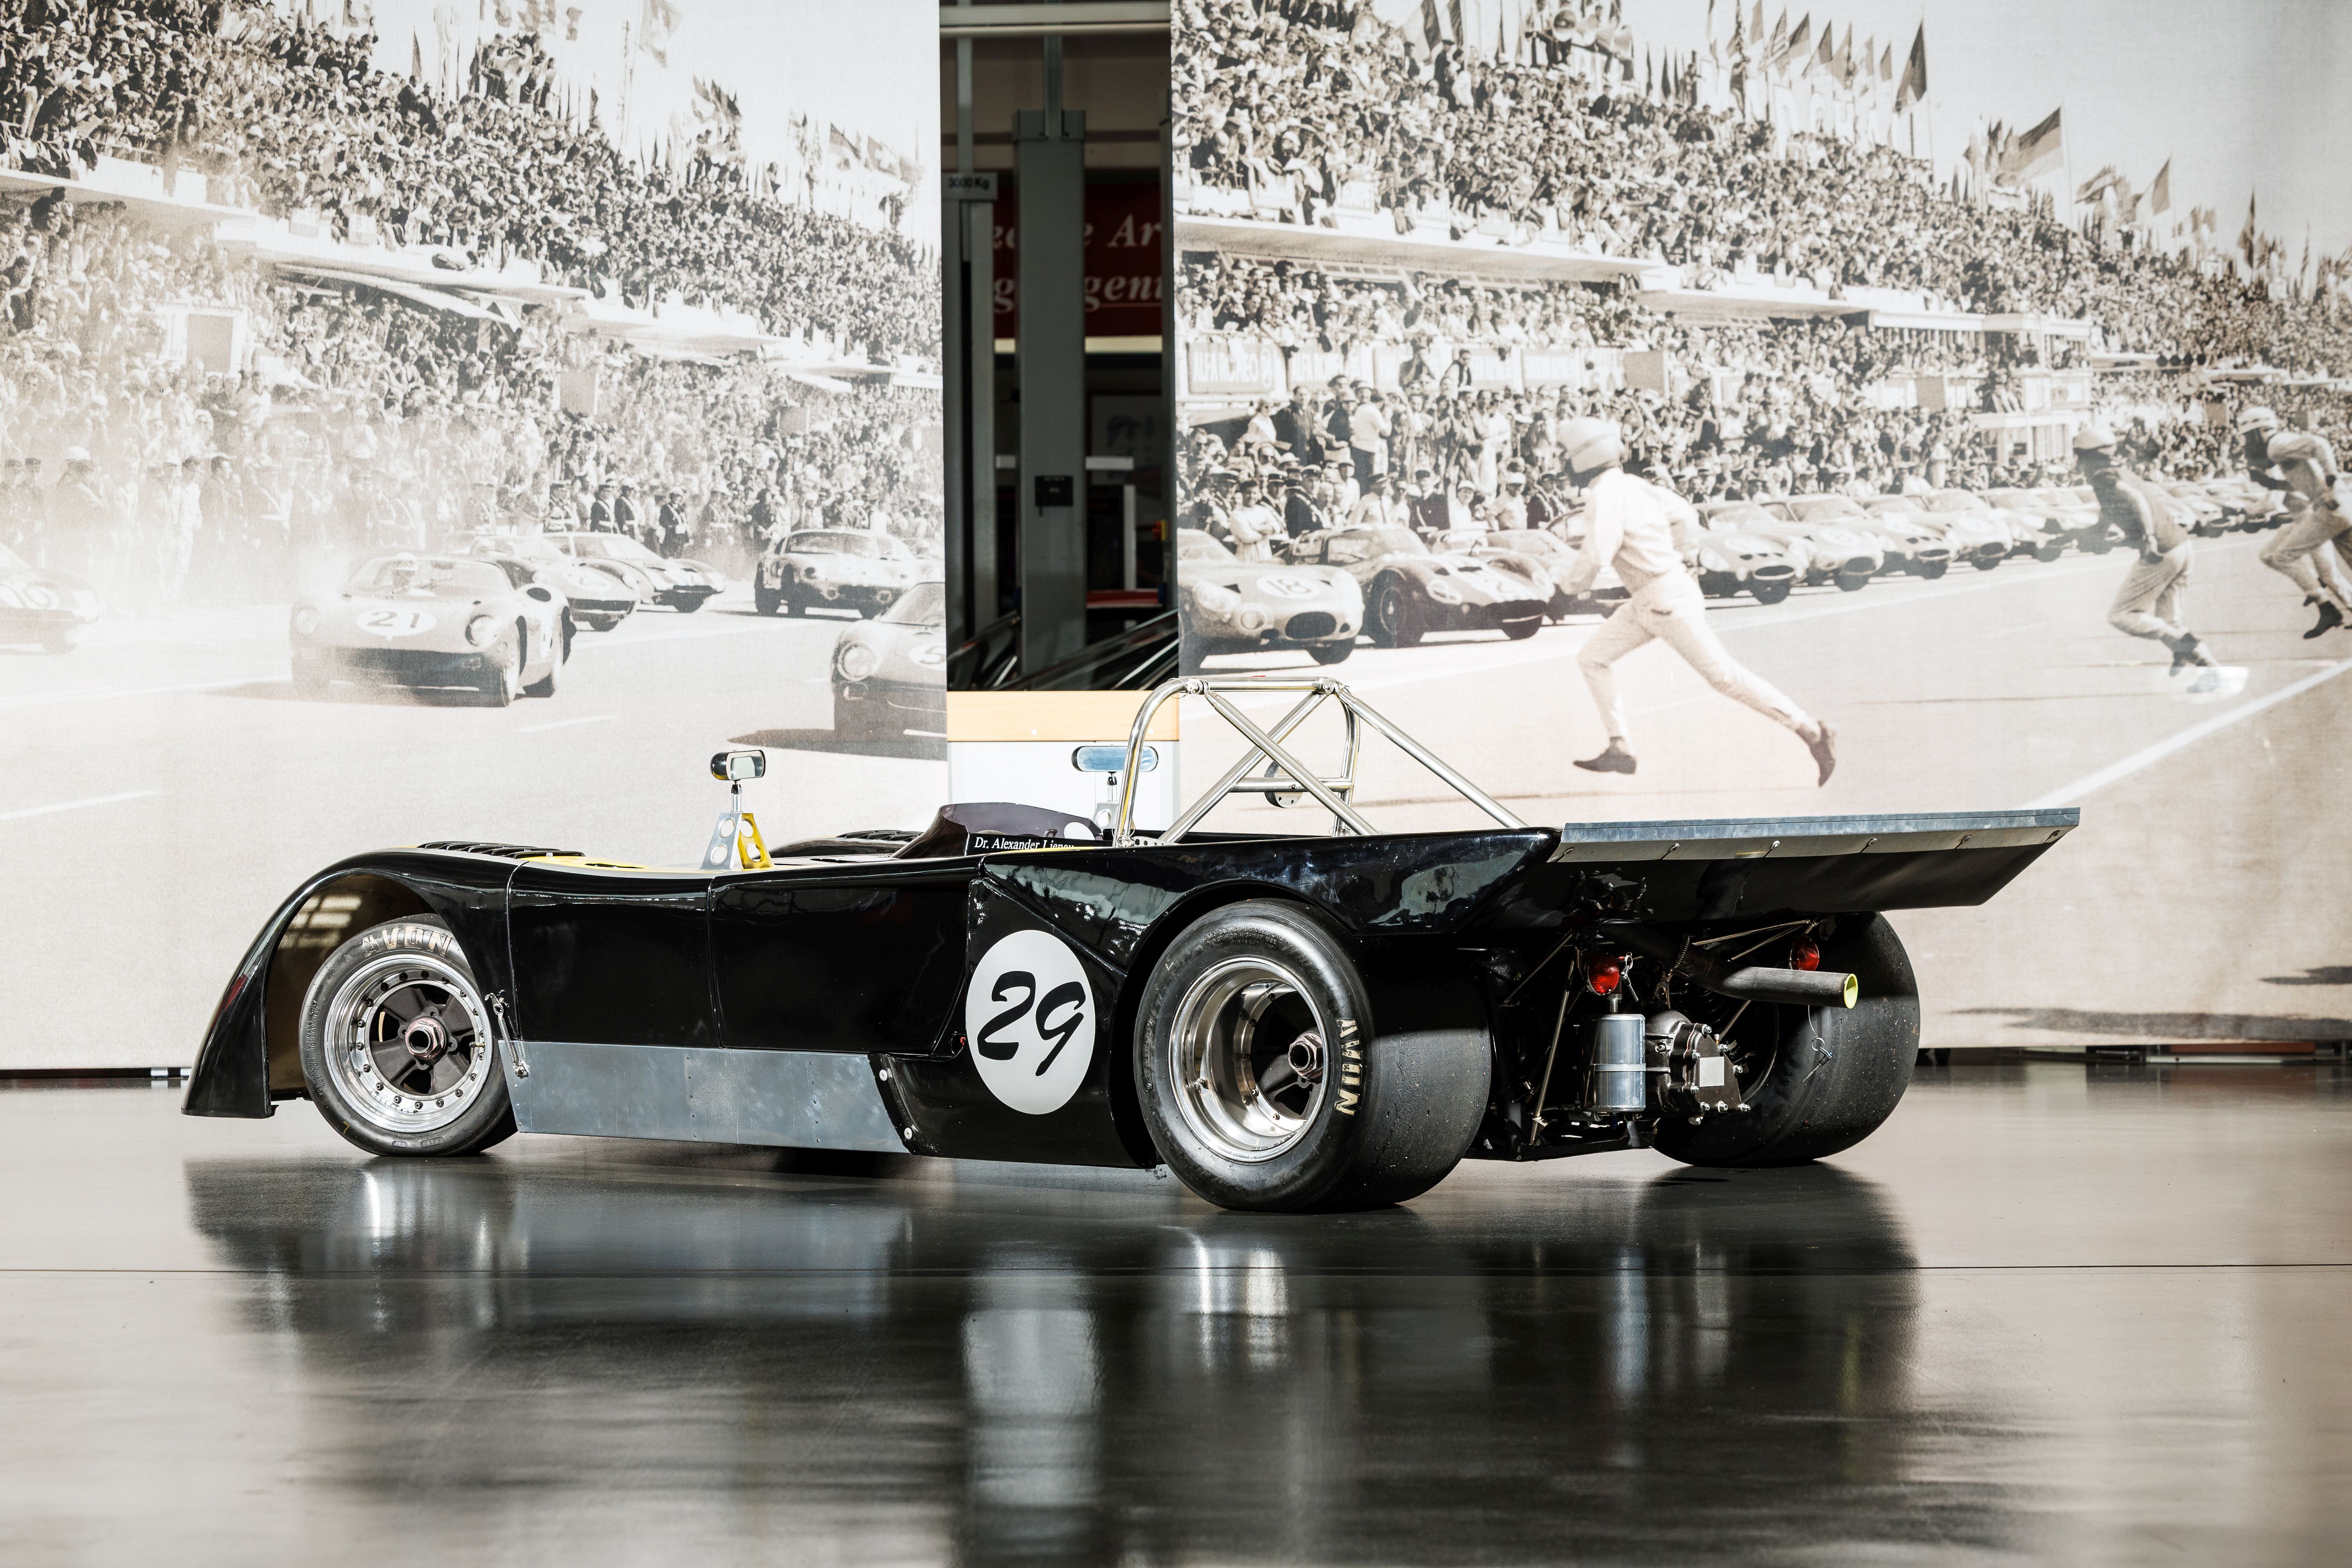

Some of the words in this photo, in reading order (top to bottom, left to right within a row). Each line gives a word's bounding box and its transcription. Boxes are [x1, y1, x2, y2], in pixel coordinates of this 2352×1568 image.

[1266, 578, 1312, 595] 18
[367, 611, 420, 628] 21
[974, 837, 989, 849] Dr.
[991, 838, 1040, 850] Alexander
[363, 926, 452, 958] AVON
[1265, 936, 1277, 945] USE
[1271, 933, 1286, 942] ONLY
[977, 971, 1086, 1077] 29
[307, 1058, 317, 1080] RACING
[1334, 1018, 1363, 1116] AVON
